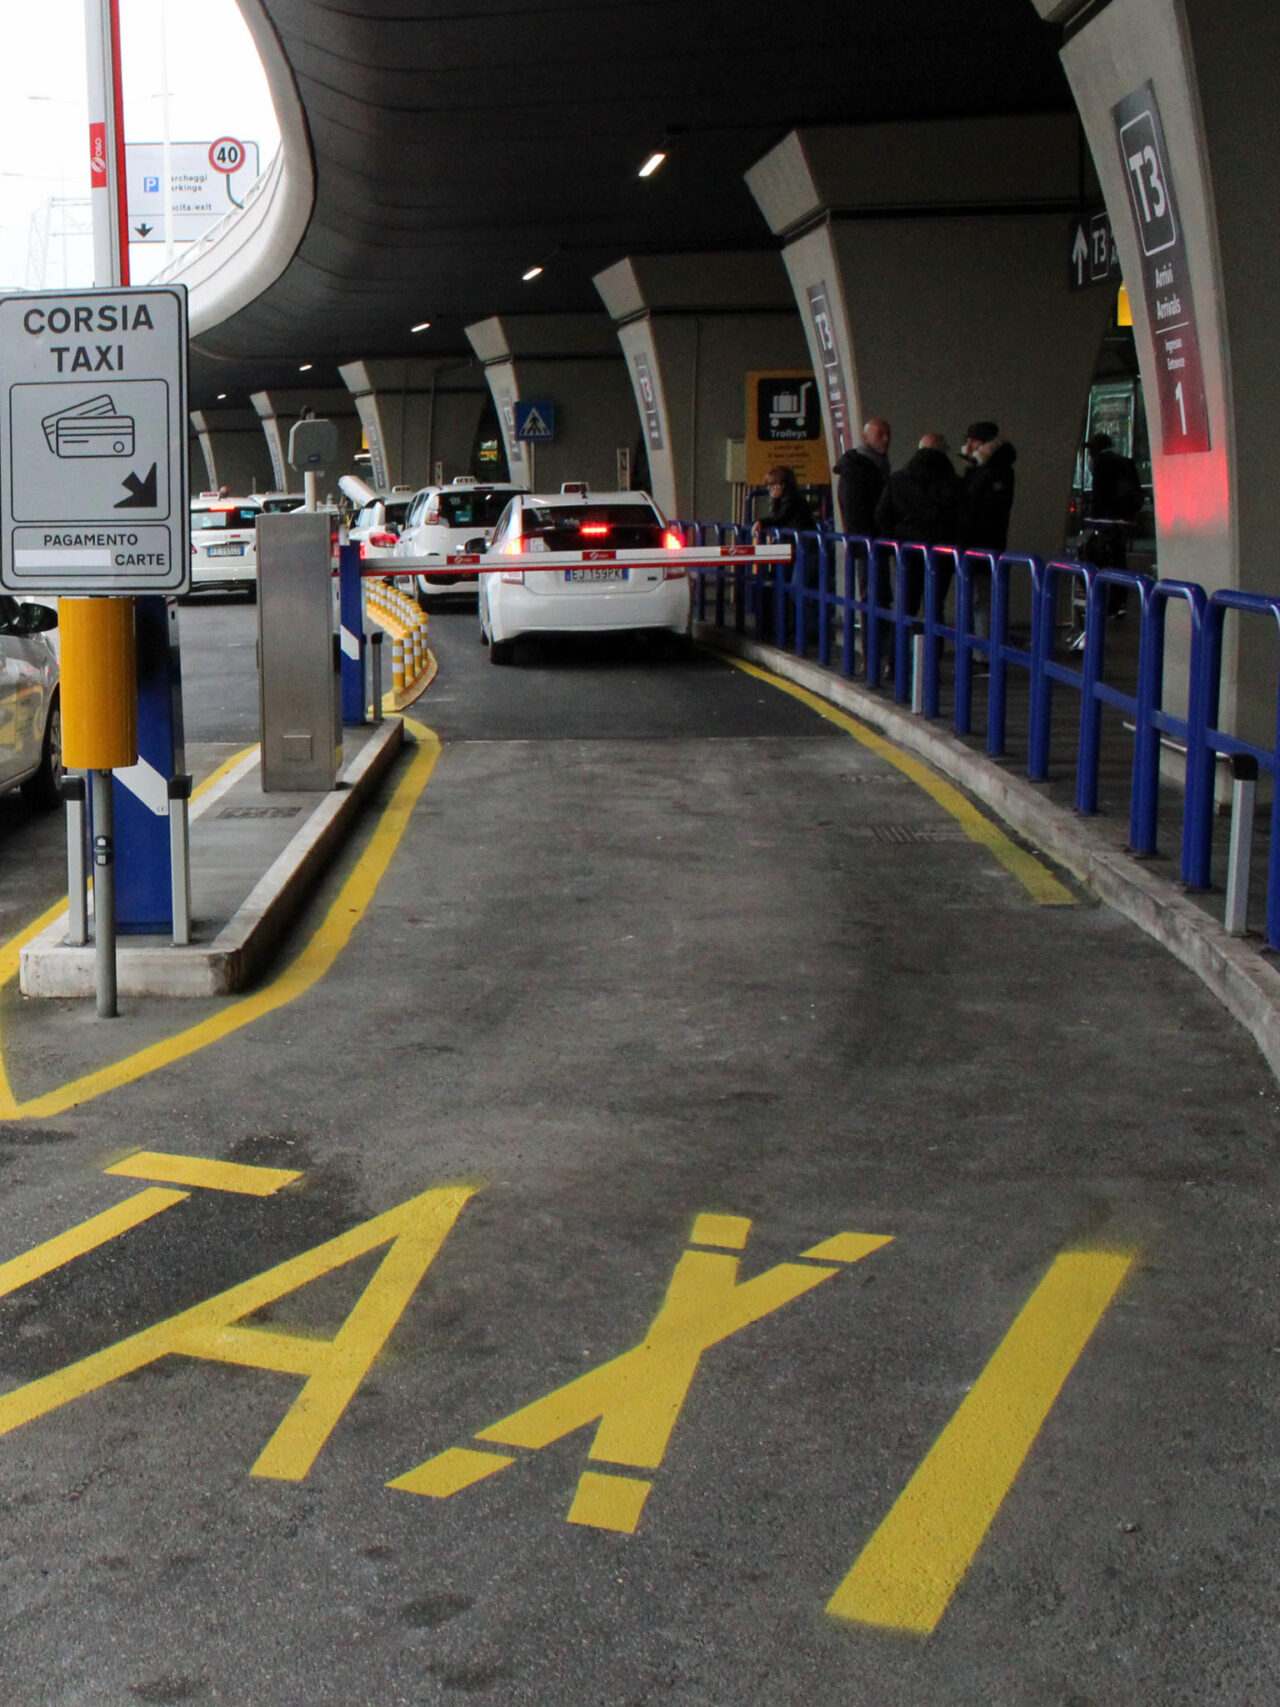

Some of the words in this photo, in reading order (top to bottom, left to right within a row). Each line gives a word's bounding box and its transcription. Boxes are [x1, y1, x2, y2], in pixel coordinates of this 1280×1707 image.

[216, 146, 239, 164] 40
[1128, 145, 1166, 223] T3
[23, 304, 154, 335] CORSIA
[50, 345, 125, 373] TAXI
[1175, 381, 1188, 436] 1
[770, 429, 808, 439] Trolleys
[44, 533, 138, 546] PAGAMENTO
[114, 553, 166, 566] CARTE
